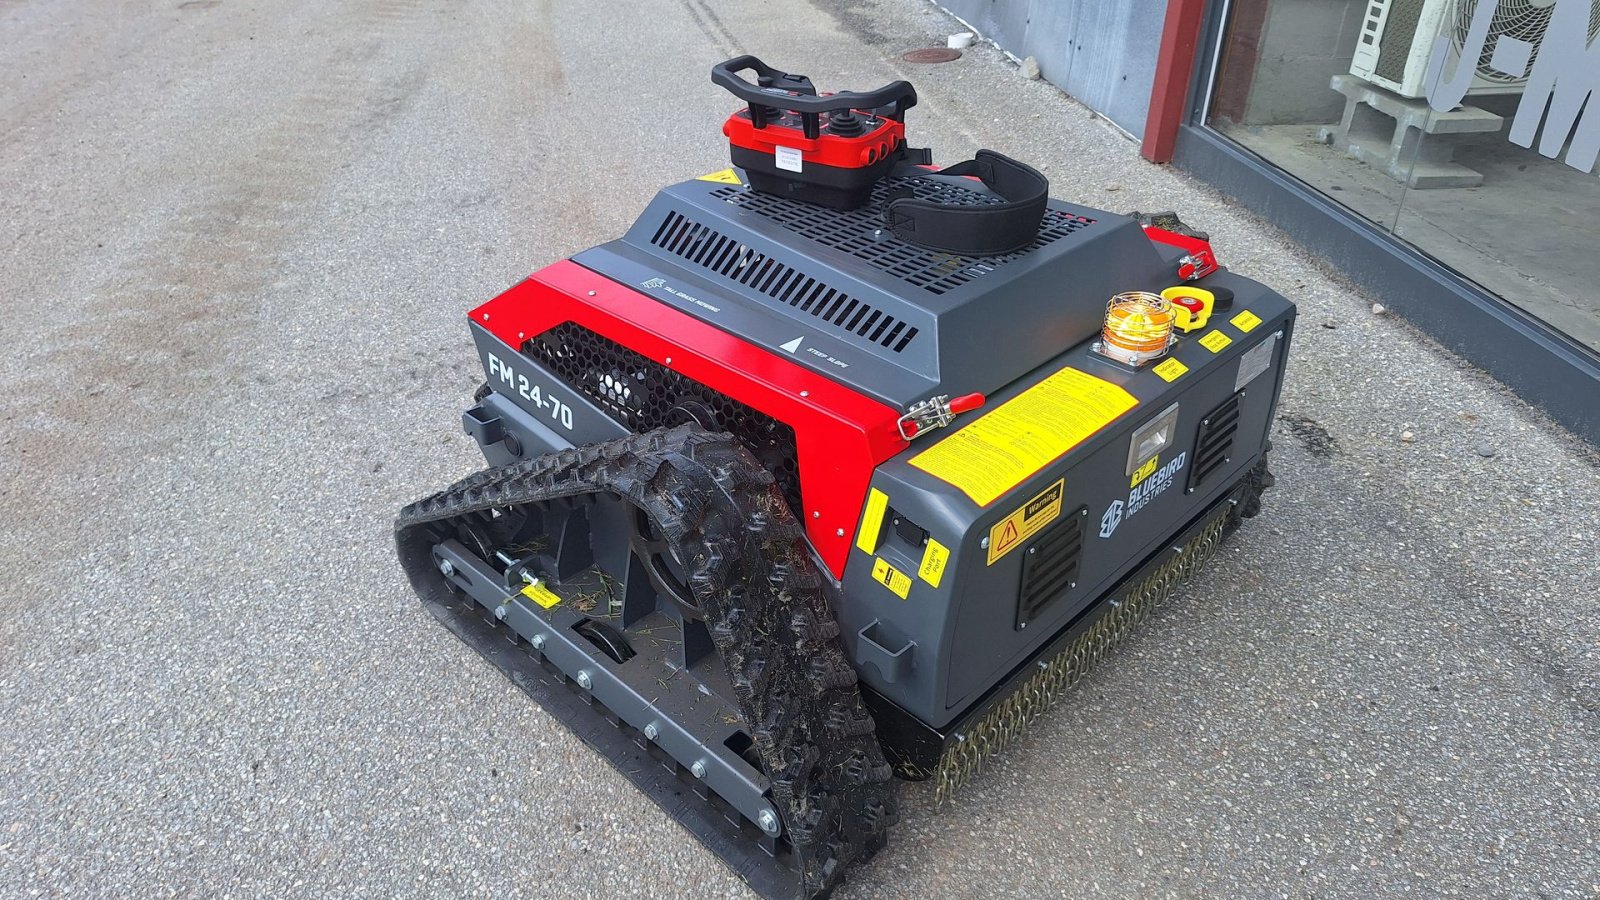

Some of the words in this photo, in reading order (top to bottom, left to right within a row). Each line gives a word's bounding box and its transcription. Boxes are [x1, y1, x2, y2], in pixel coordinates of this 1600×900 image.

[676, 291, 697, 303] GRASS
[806, 347, 829, 358] STEEP
[826, 356, 849, 369] SLOPE
[487, 351, 515, 390] FM
[518, 373, 574, 431] 24-70
[1127, 451, 1187, 509] BLUEBIRD
[1029, 490, 1058, 515] Warning
[1125, 476, 1173, 520] INDUSTRIES
[923, 547, 940, 576] Charging
[932, 558, 942, 573] Port
